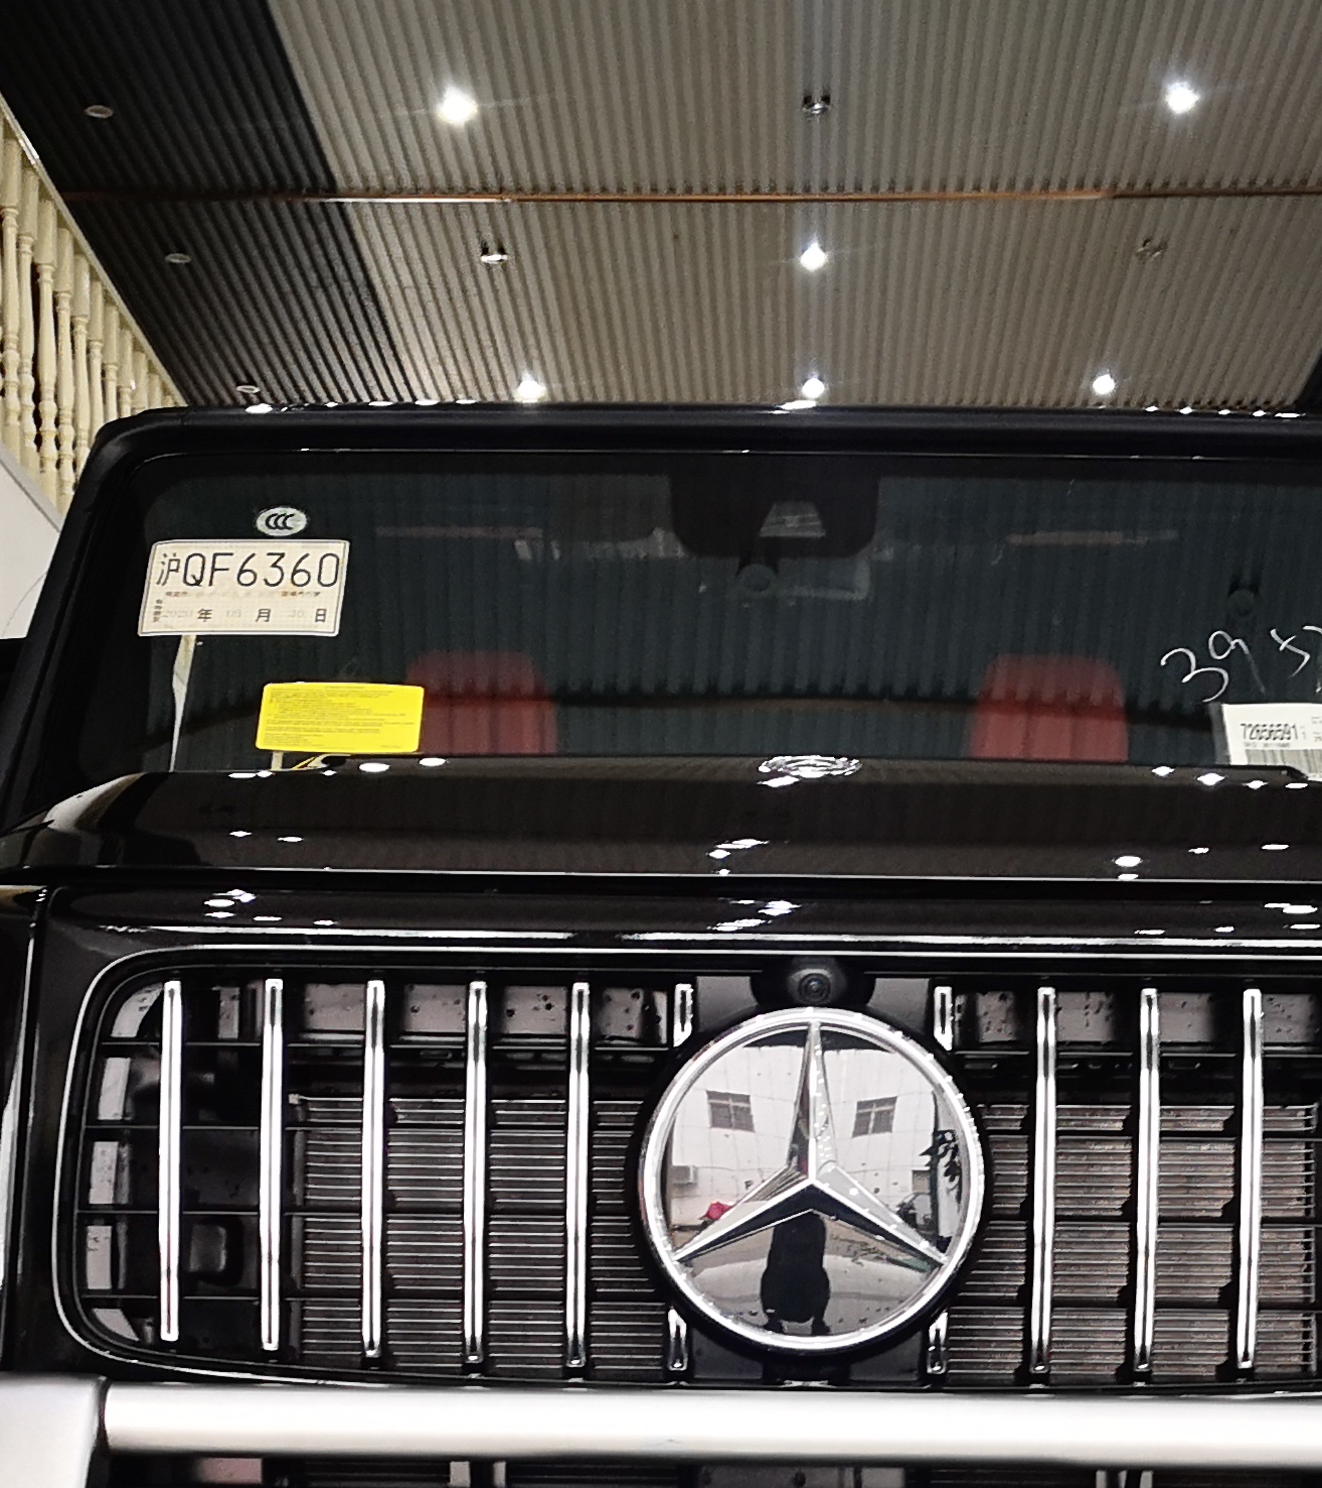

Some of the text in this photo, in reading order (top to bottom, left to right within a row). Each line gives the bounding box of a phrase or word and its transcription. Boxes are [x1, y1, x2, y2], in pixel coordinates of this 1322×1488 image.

[156, 552, 340, 587] 沪QF6360
[197, 608, 213, 622] 年
[255, 608, 271, 622] 月
[315, 608, 327, 622] 日
